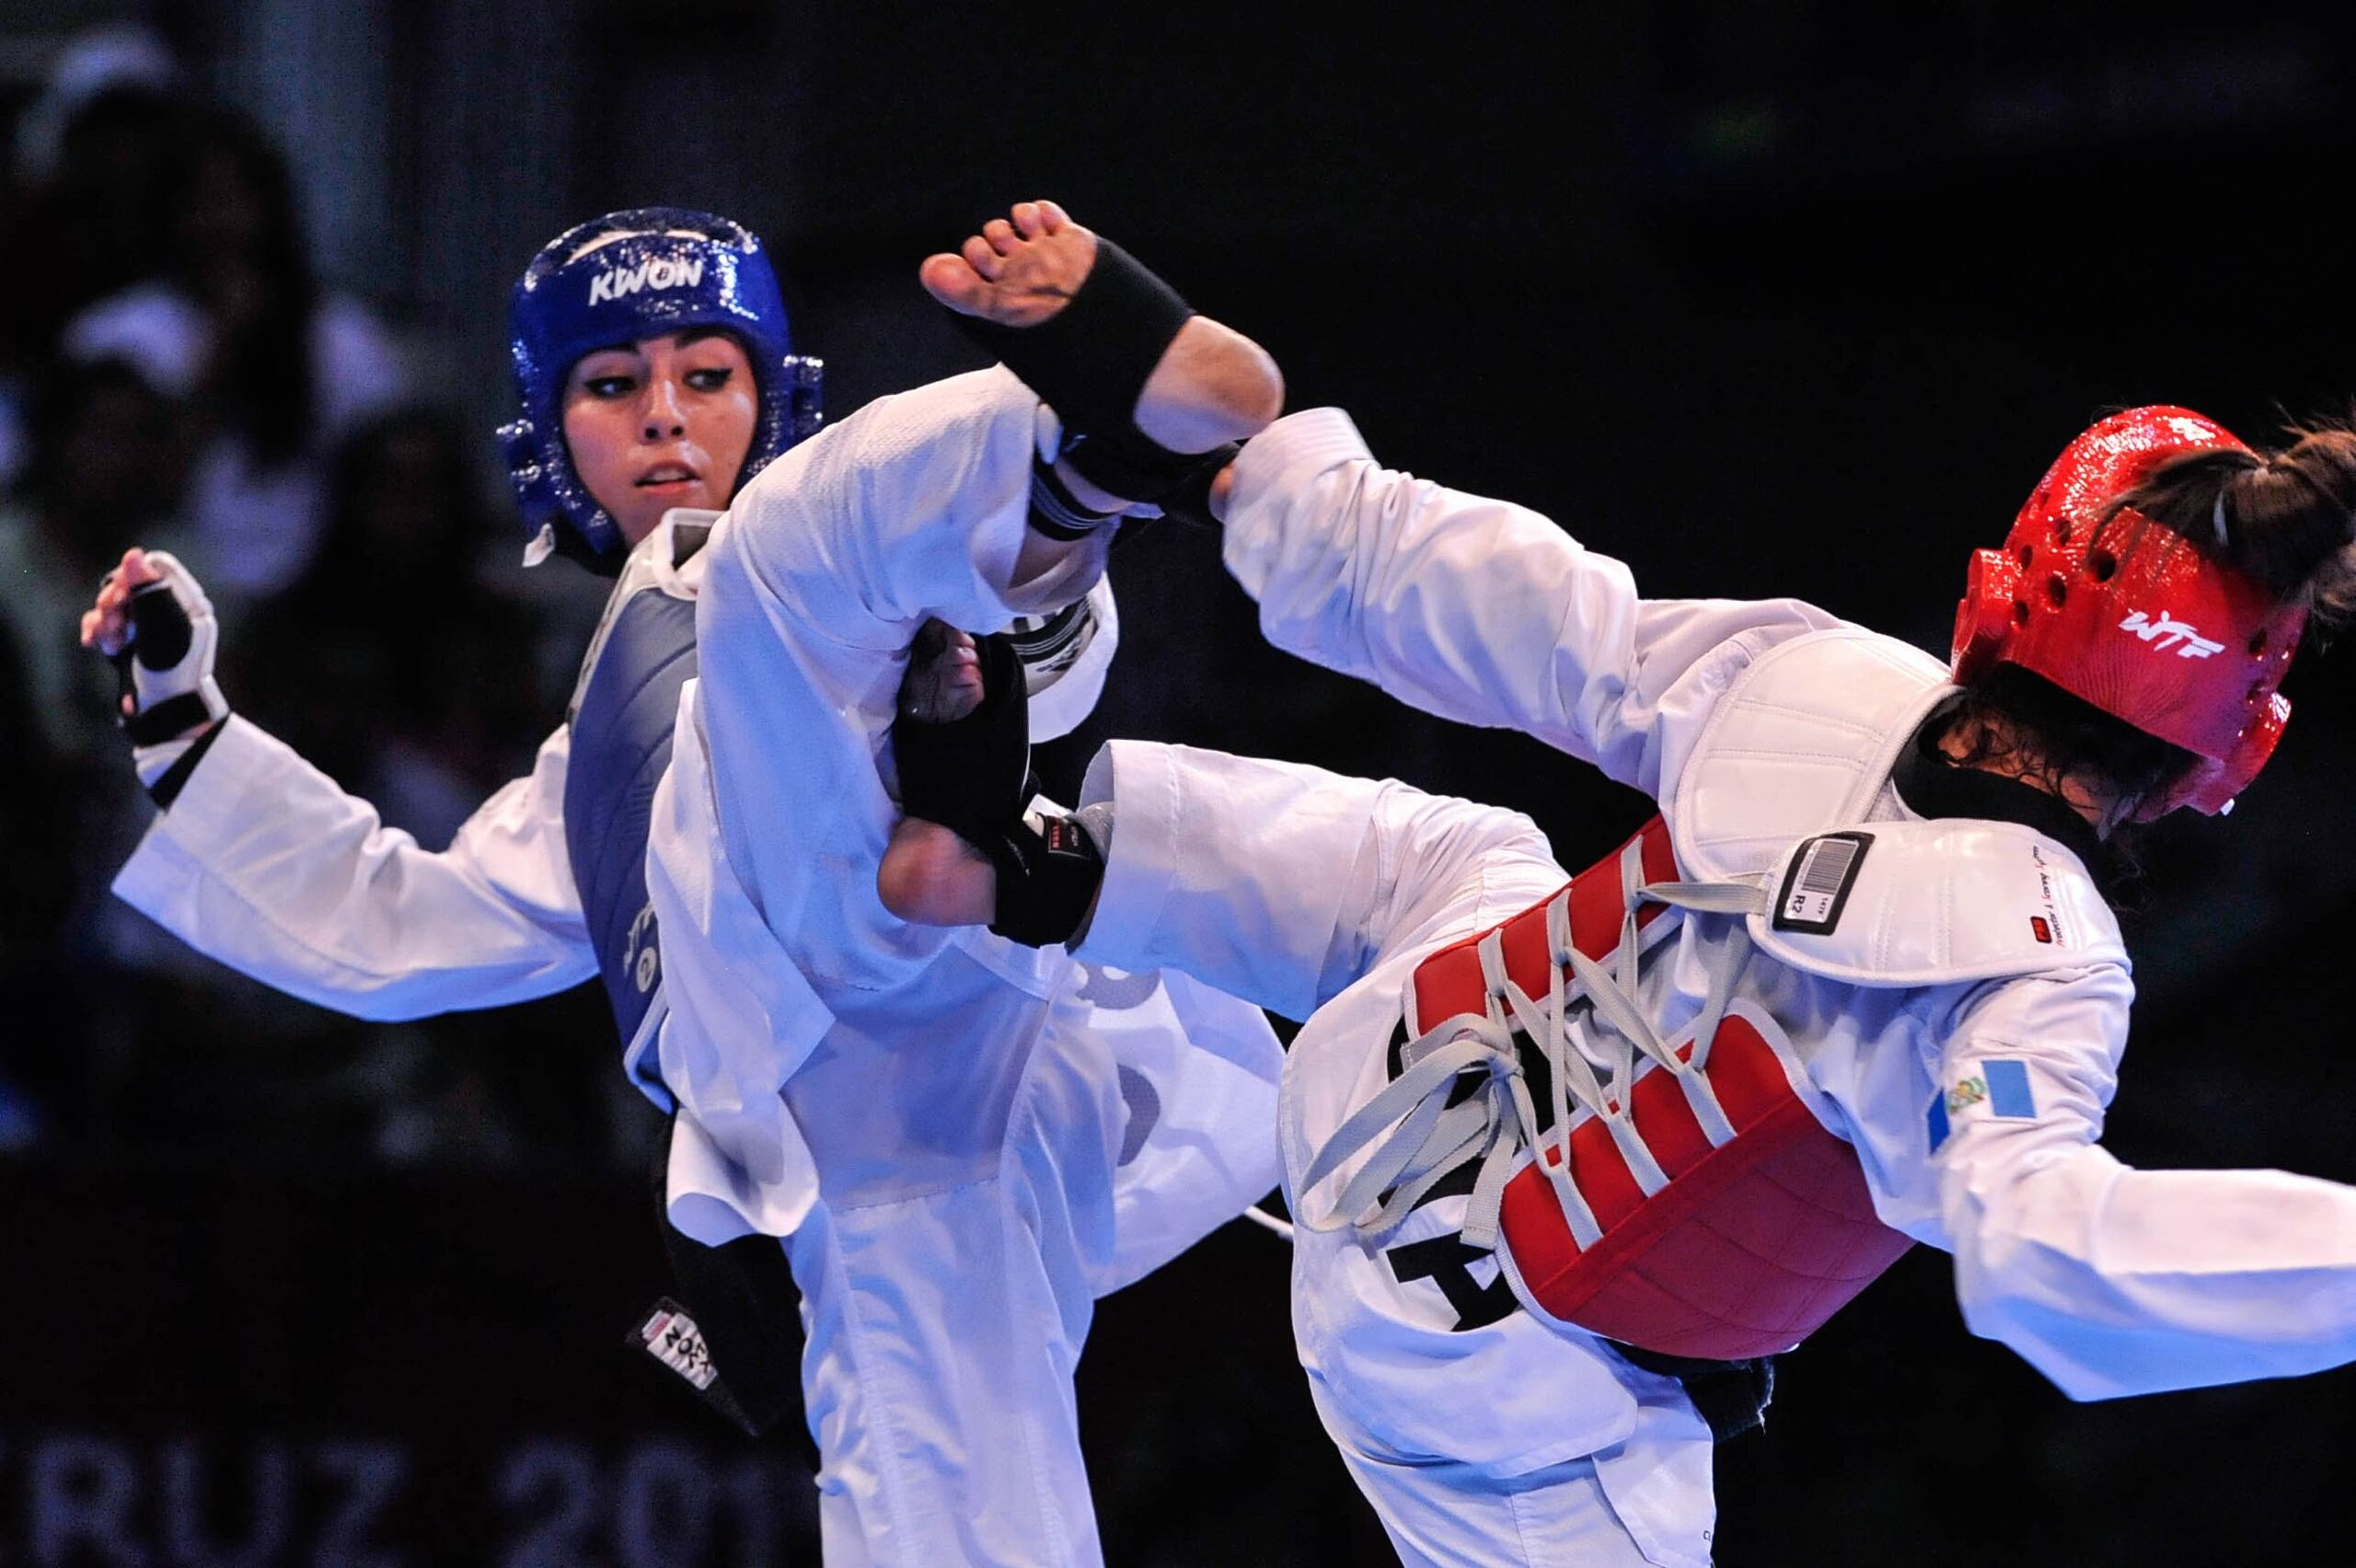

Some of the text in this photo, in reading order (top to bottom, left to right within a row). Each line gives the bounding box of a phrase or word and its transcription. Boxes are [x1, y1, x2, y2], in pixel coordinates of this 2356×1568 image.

[588, 259, 703, 306] KWON
[2118, 607, 2225, 659] WTF
[1791, 894, 1807, 914] R2
[0, 1435, 412, 1568] RUZ
